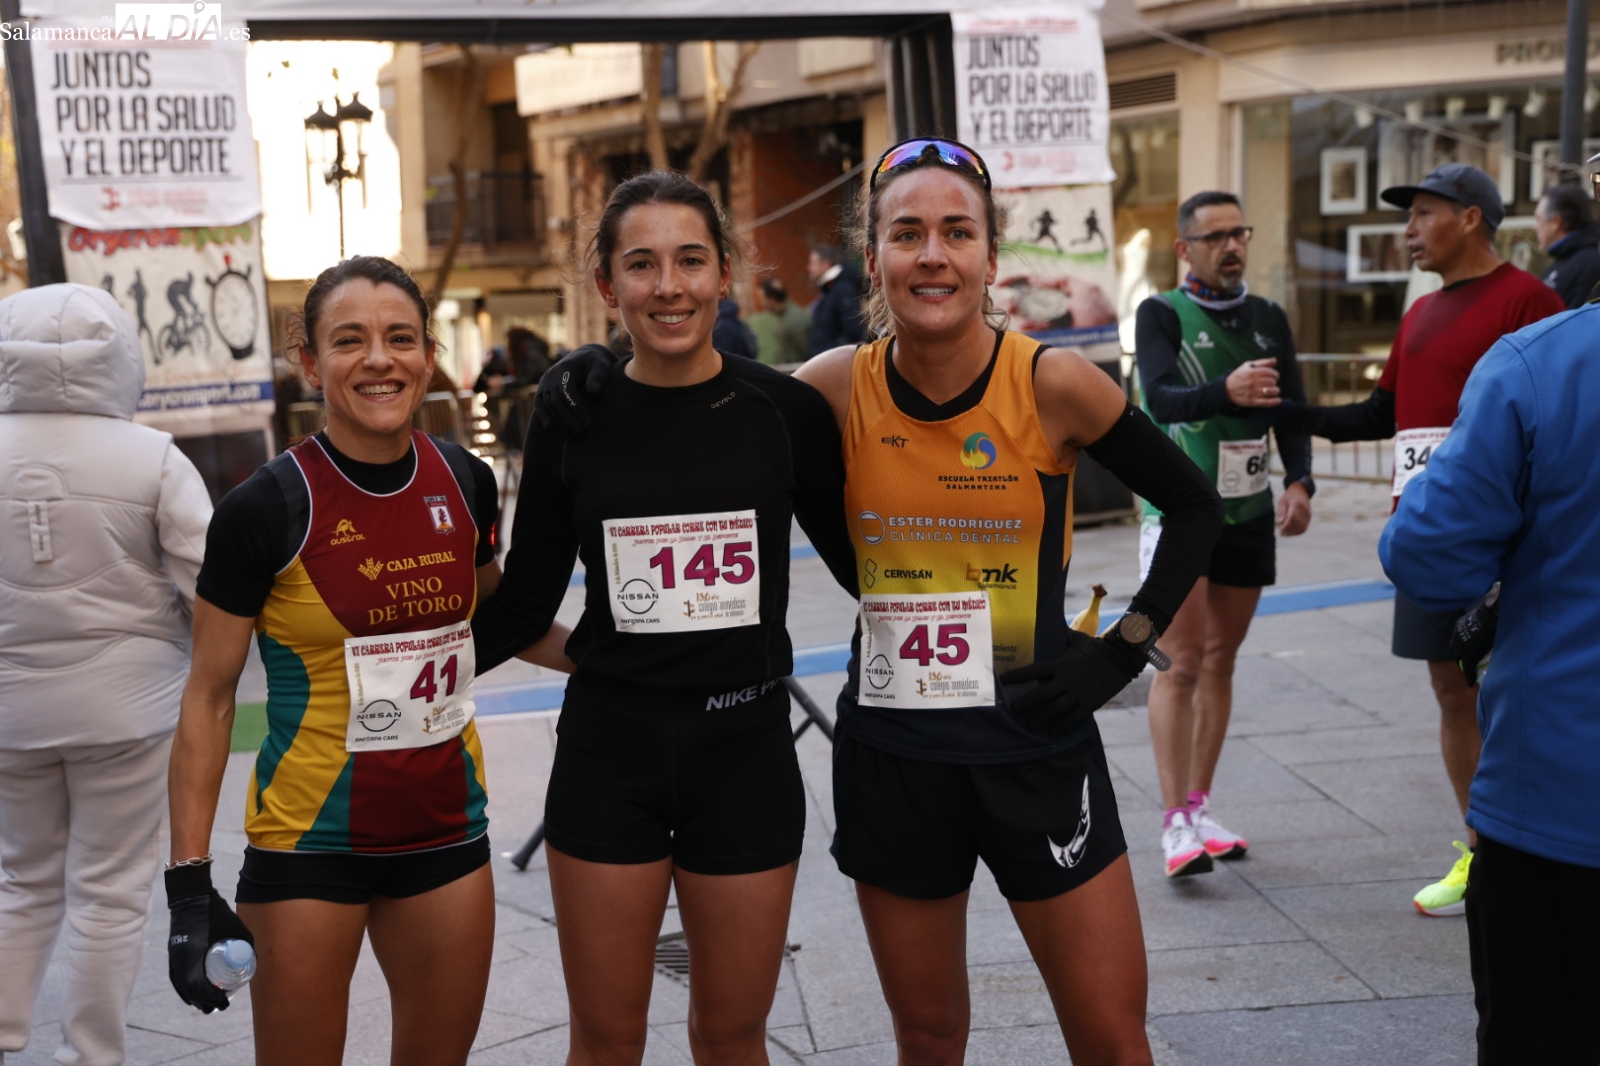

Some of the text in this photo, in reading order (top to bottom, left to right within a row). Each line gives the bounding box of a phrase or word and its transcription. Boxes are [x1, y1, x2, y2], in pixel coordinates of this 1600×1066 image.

[967, 35, 1040, 70] JUNTOS
[51, 52, 151, 90] JUNTOS
[969, 72, 1097, 106] POR LA SALUD
[56, 95, 236, 133] POR LA SALUD
[970, 107, 1093, 142] Y EL DEPORTE
[60, 137, 231, 176] Y EL DEPORTE
[711, 391, 736, 409] DEVOLD
[977, 474, 1018, 482] TRIATLÓN
[888, 514, 1022, 529] ESTER RODRÍGUEZ
[890, 528, 1020, 544] CLÍNICA DENTAL
[386, 551, 456, 572] CAJA RURAL
[649, 541, 756, 590] 145
[884, 568, 933, 579] CERVISÁN
[385, 576, 443, 600] VINO
[368, 594, 463, 625] DE TORO
[361, 641, 394, 656] CARRERA
[899, 623, 970, 667] 45
[410, 654, 458, 704] 41
[865, 667, 894, 677] NISSAN
[705, 685, 758, 711] NIKE
[357, 711, 402, 720] NISSAN
